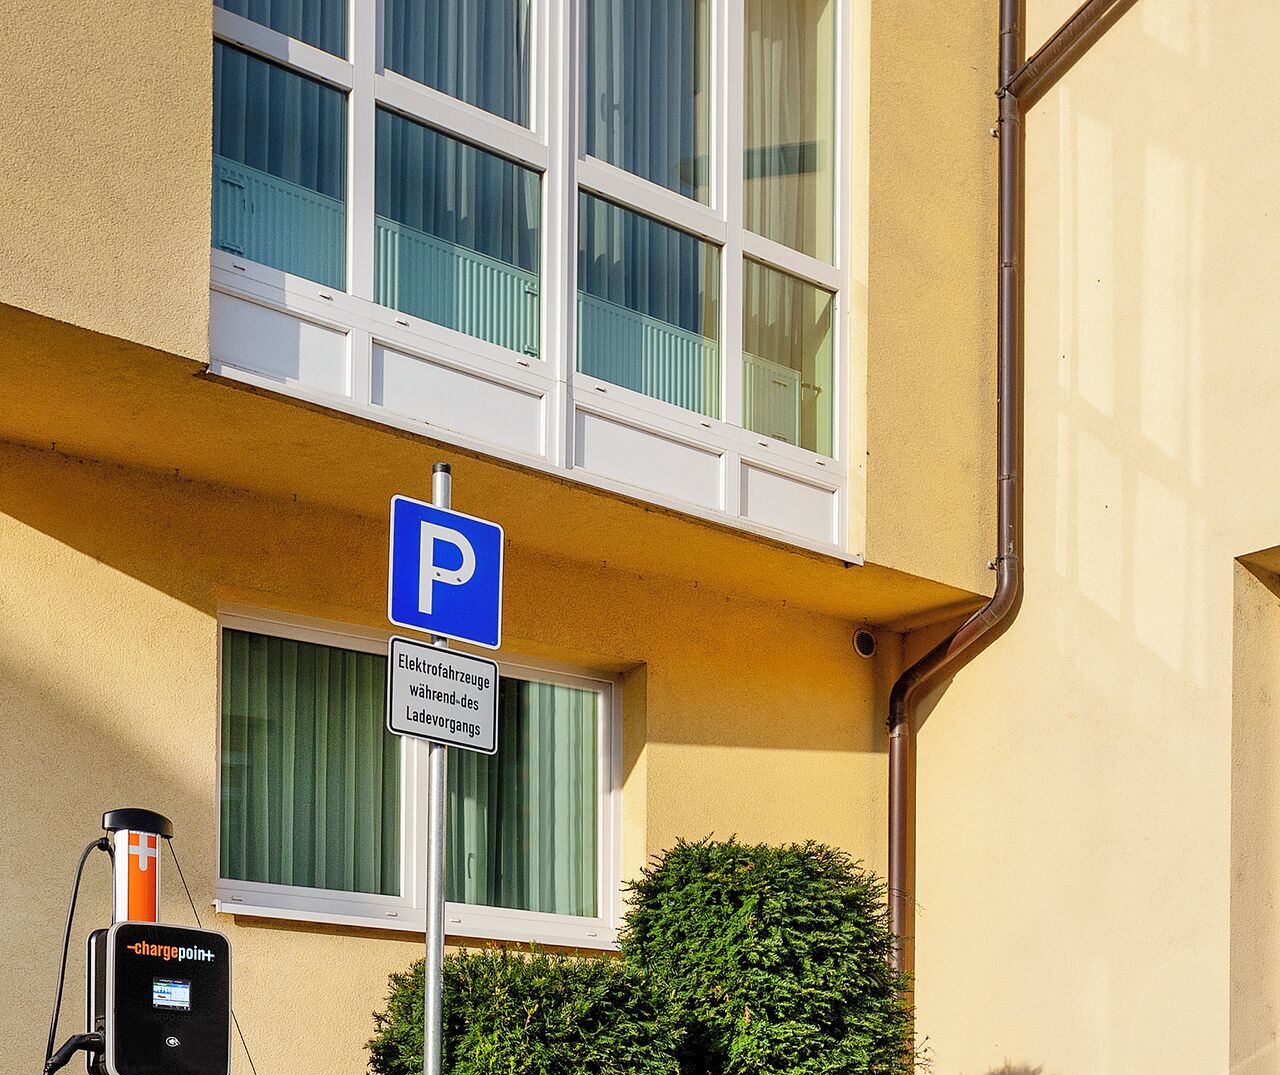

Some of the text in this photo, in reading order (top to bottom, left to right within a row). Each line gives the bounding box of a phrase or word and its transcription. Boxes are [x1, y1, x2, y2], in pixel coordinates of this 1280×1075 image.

[418, 520, 477, 615] P
[398, 653, 491, 692] Elektrofahrzeuge
[409, 682, 480, 712] während des
[405, 704, 481, 739] Ladevorgangs
